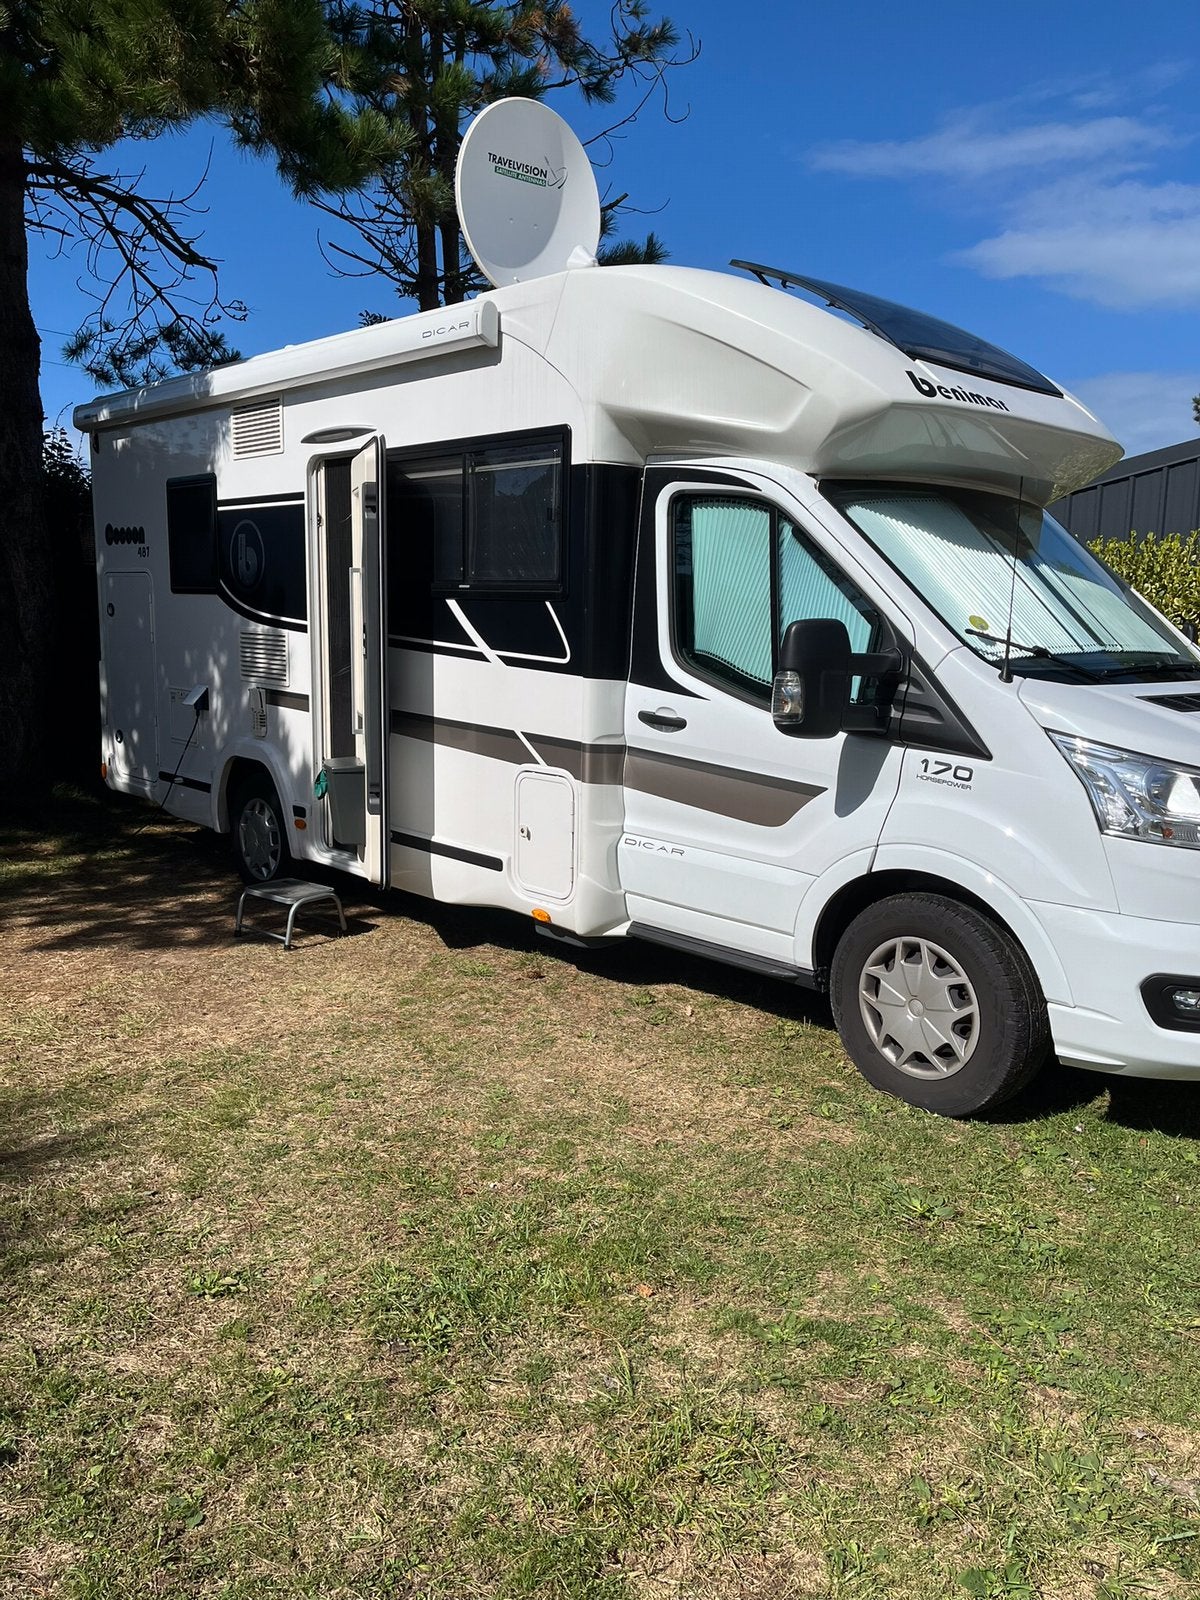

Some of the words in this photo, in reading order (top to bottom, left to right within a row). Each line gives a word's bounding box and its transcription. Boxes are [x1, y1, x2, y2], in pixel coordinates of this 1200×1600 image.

[488, 152, 548, 179] TRAVELVISION
[518, 173, 546, 186] ANTENNAS
[422, 321, 470, 338] DICAR
[905, 370, 1010, 412] benimar
[921, 758, 974, 782] 170
[916, 774, 972, 791] HORSEPOWER
[624, 838, 685, 856] DICAR
